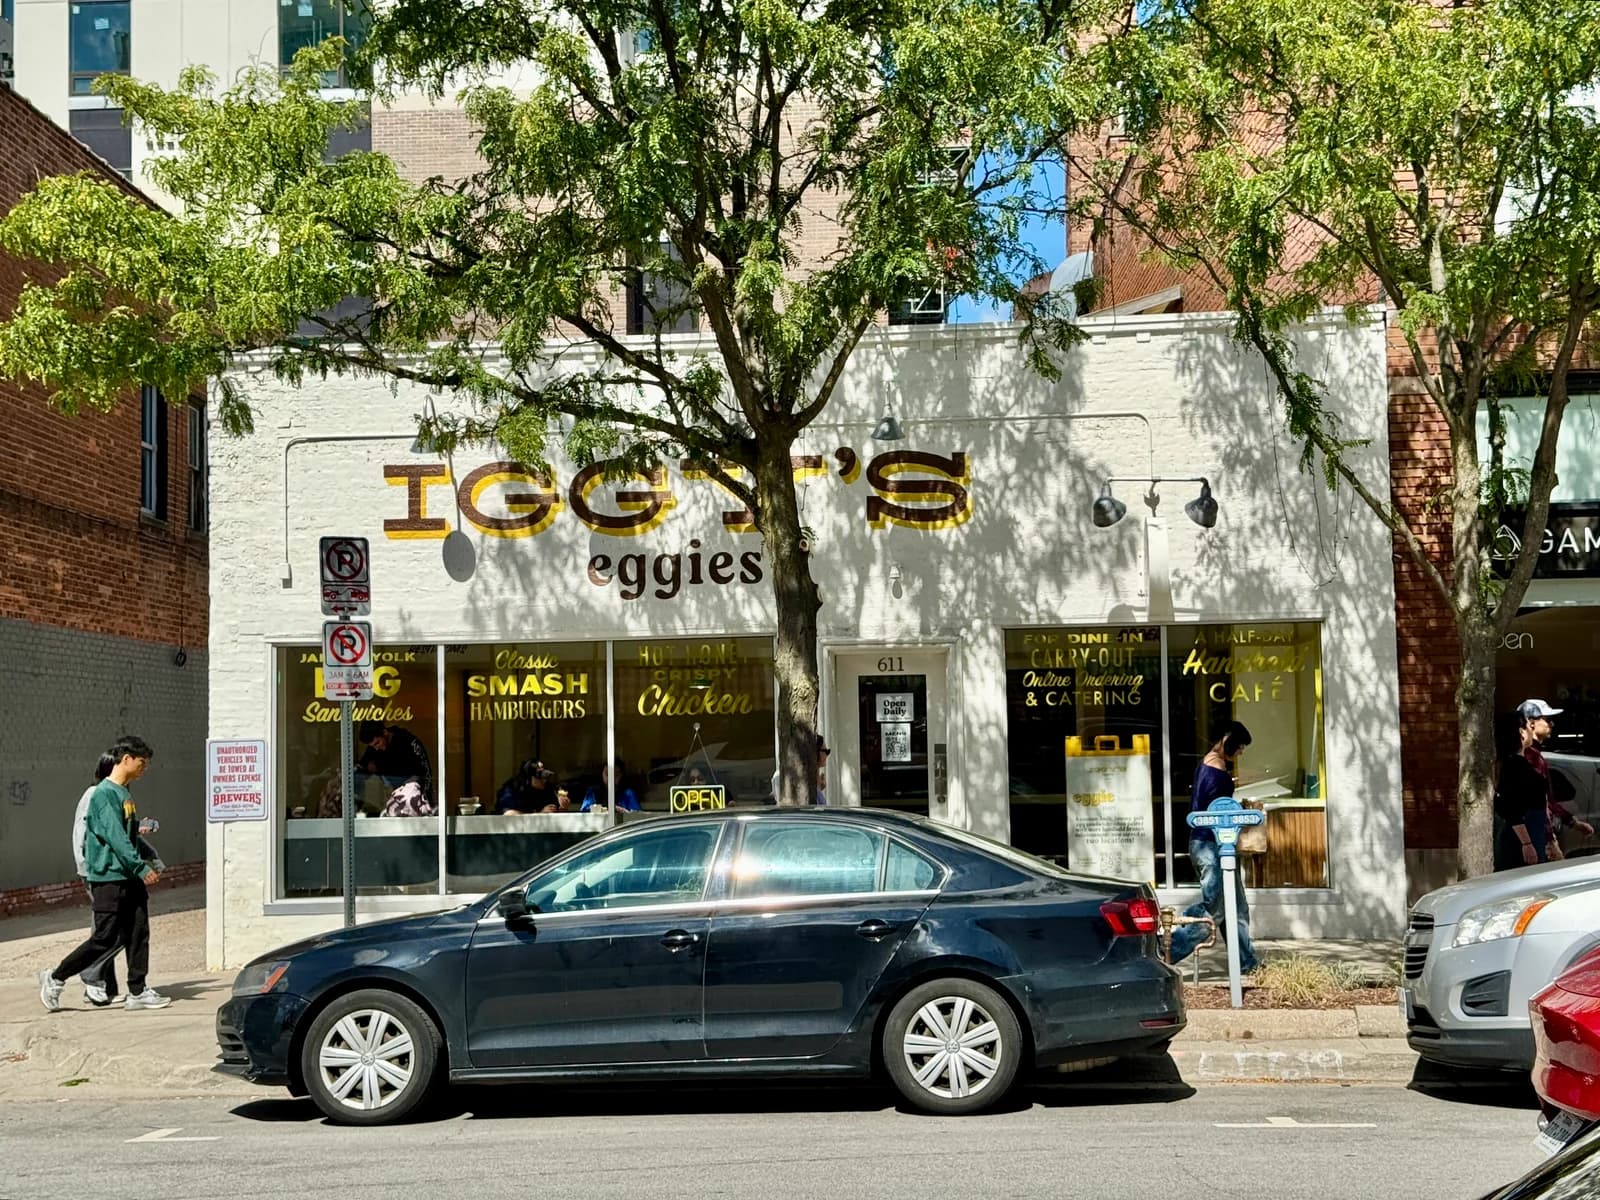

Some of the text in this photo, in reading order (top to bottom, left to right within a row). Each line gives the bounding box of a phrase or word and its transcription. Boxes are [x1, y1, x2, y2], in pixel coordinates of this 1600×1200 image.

[587, 539, 763, 600] eggies
[495, 649, 559, 670] Classic
[686, 643, 748, 664] HONE
[1031, 647, 1135, 668] CARRY-OUT
[877, 656, 904, 672] 611
[654, 667, 737, 680] CRISPY
[1022, 671, 1144, 693] Online Ordering
[467, 673, 588, 697] SMASH
[637, 683, 752, 716] Chicken
[883, 700, 906, 709] Open
[1025, 691, 1141, 706] & CATERING
[470, 699, 586, 720] HAMBURGERS
[883, 707, 907, 717] Daily
[217, 746, 257, 754] UNAUTHORIZED
[217, 755, 257, 764] VEHICLES WILL
[228, 765, 247, 773] TOWED
[213, 774, 261, 783] OWNERS EXPENSE
[673, 789, 723, 812] OPEN
